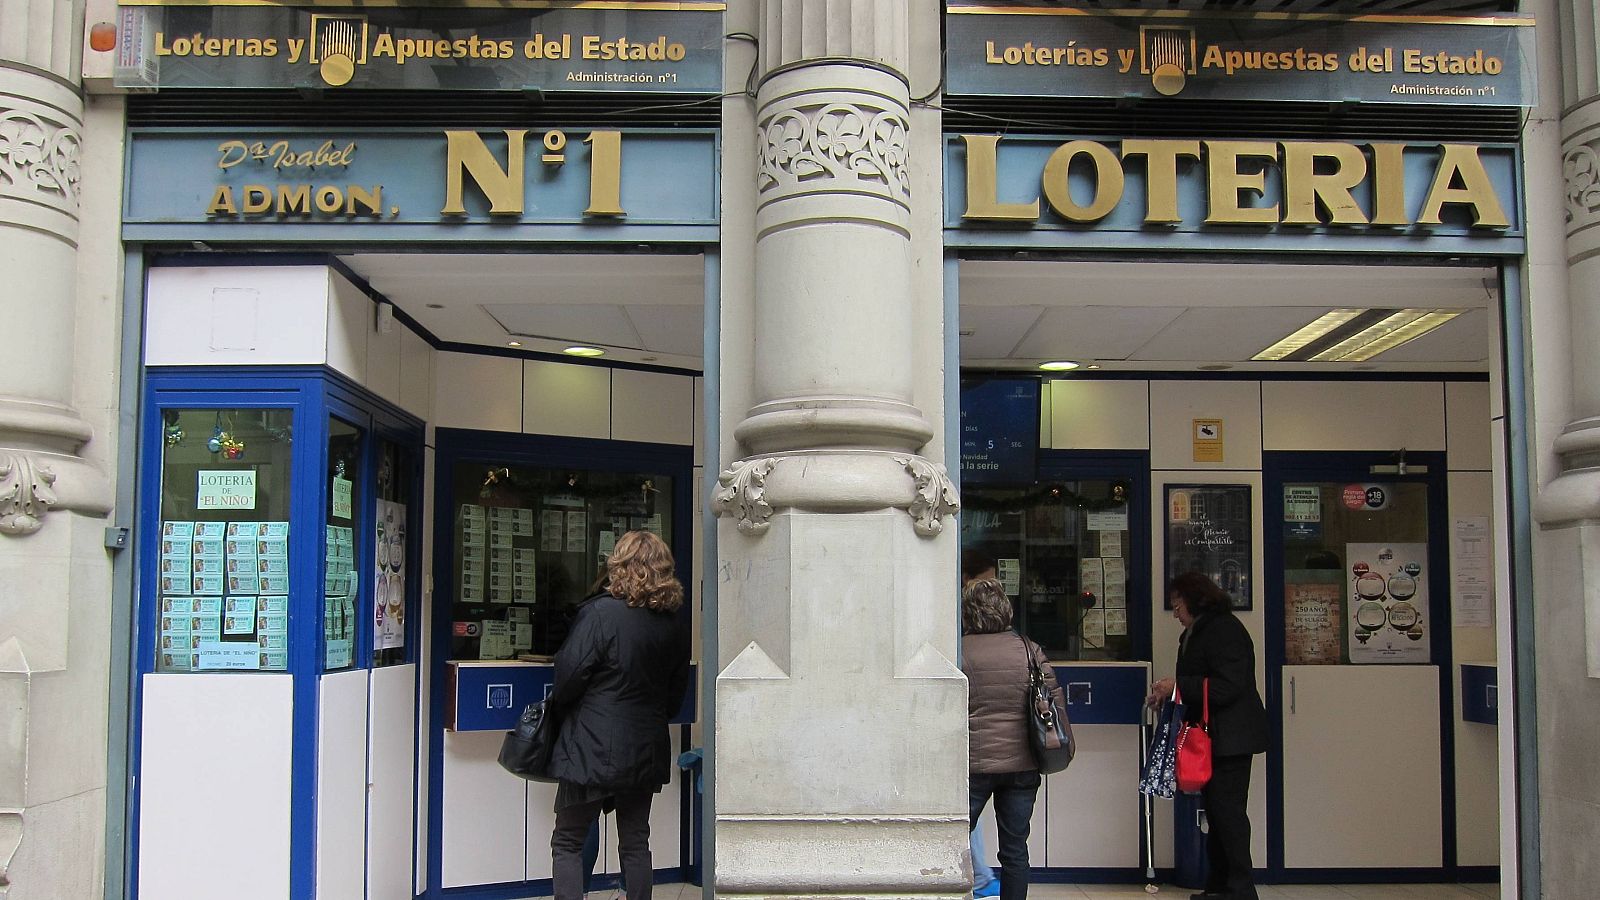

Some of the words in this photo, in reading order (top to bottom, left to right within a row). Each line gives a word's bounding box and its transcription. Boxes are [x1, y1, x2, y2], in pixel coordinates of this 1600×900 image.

[287, 38, 305, 64] y
[372, 33, 514, 64] Apuestas
[524, 33, 571, 59] del
[582, 35, 686, 61] Estado
[986, 41, 1109, 66] Loterías
[1118, 49, 1135, 73] y
[1203, 45, 1338, 75] Apuestas
[1348, 47, 1393, 72] del
[1403, 49, 1503, 75] Estado
[566, 71, 653, 83] Administración
[1390, 84, 1473, 96] Administración
[267, 140, 355, 168] Isabel
[959, 134, 1510, 229] LOTERIA
[205, 185, 399, 218] ADMON.
[988, 440, 994, 449] 5
[966, 461, 974, 469] la
[976, 461, 999, 470] serie
[201, 475, 253, 486] LOTERIA
[222, 487, 232, 495] DE
[1367, 491, 1382, 499] +18
[1308, 605, 1328, 613] AÑOS
